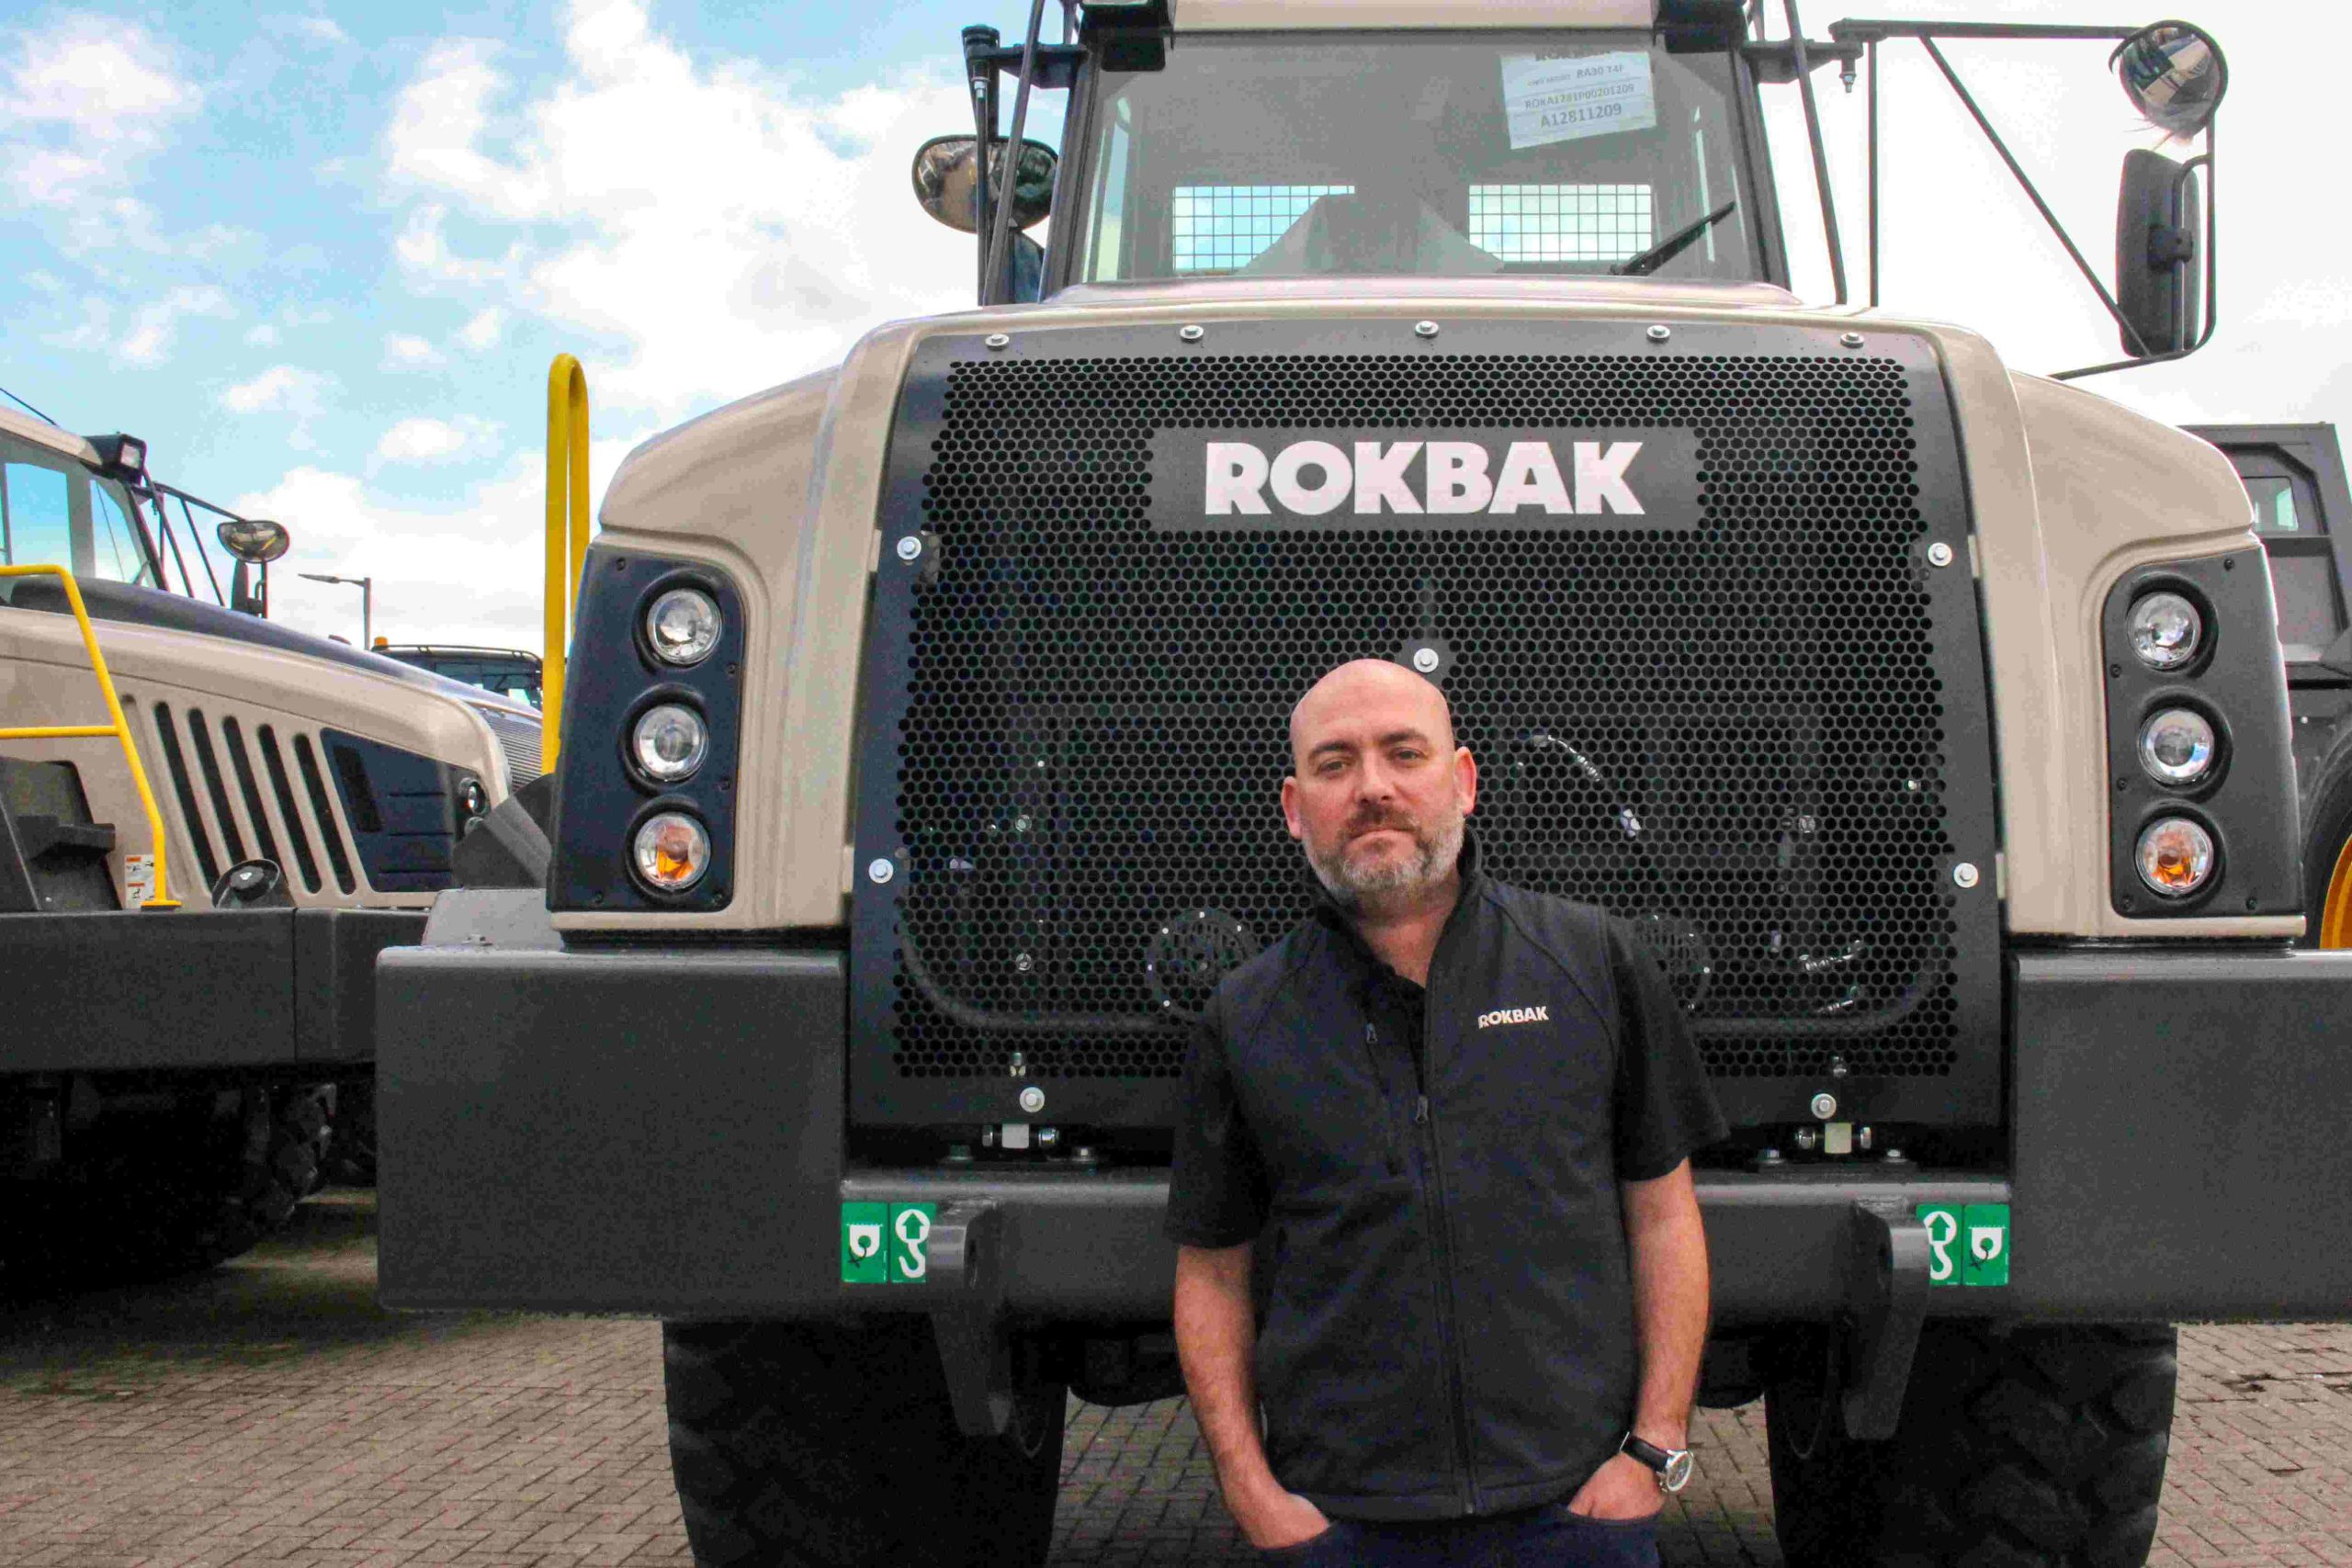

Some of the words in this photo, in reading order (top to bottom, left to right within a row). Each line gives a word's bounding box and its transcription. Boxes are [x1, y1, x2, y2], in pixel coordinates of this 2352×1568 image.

[1540, 103, 1623, 129] A12811209
[1204, 440, 1645, 515] ROKBAK
[1477, 1006, 1550, 1029] ROKBAK
